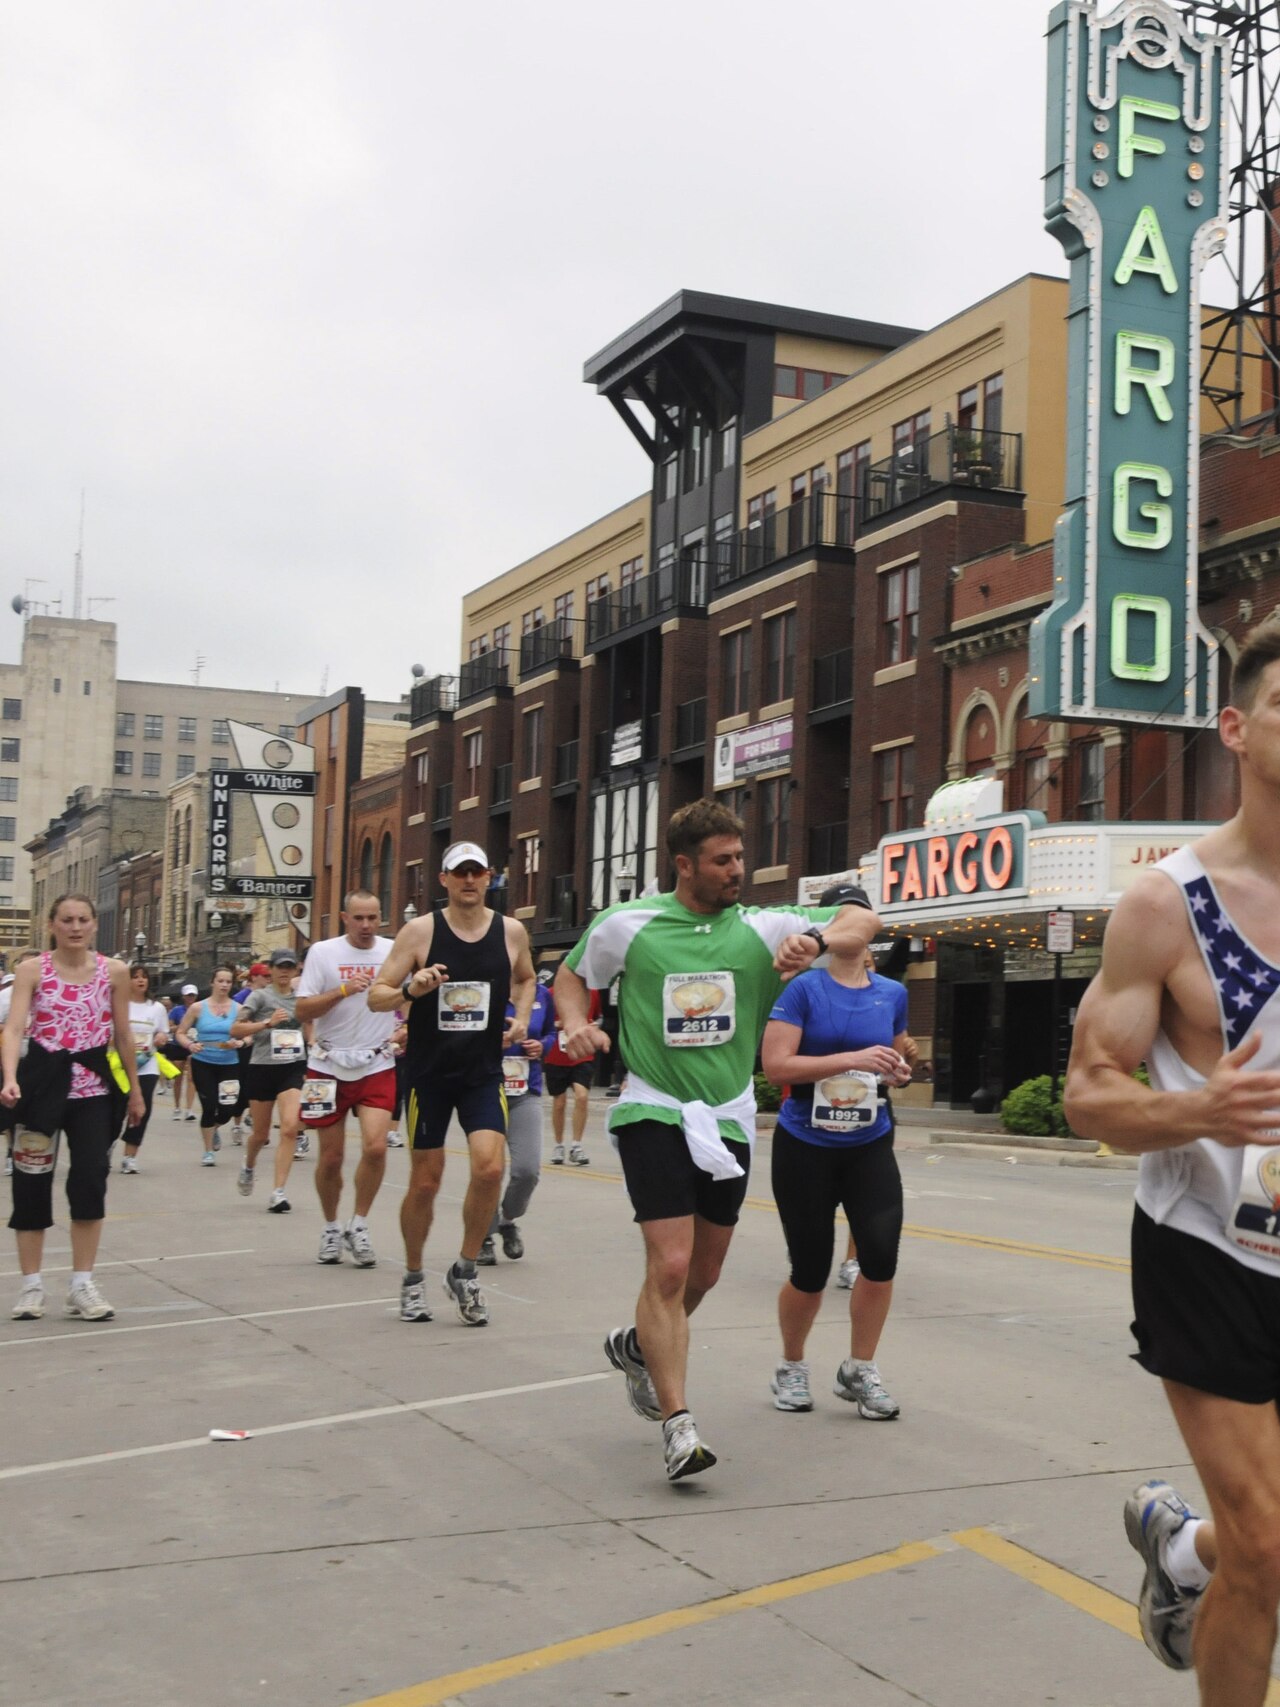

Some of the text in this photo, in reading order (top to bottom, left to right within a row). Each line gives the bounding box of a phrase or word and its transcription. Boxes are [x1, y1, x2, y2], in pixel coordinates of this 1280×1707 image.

[1110, 94, 1181, 683] FARGO
[244, 773, 303, 791] White
[211, 774, 229, 892] UNIFORMS
[882, 825, 1013, 904] FARGO
[236, 879, 306, 896] Banner
[454, 1013, 472, 1021] 251
[681, 1019, 718, 1032] 2612
[828, 1109, 860, 1121] 1992
